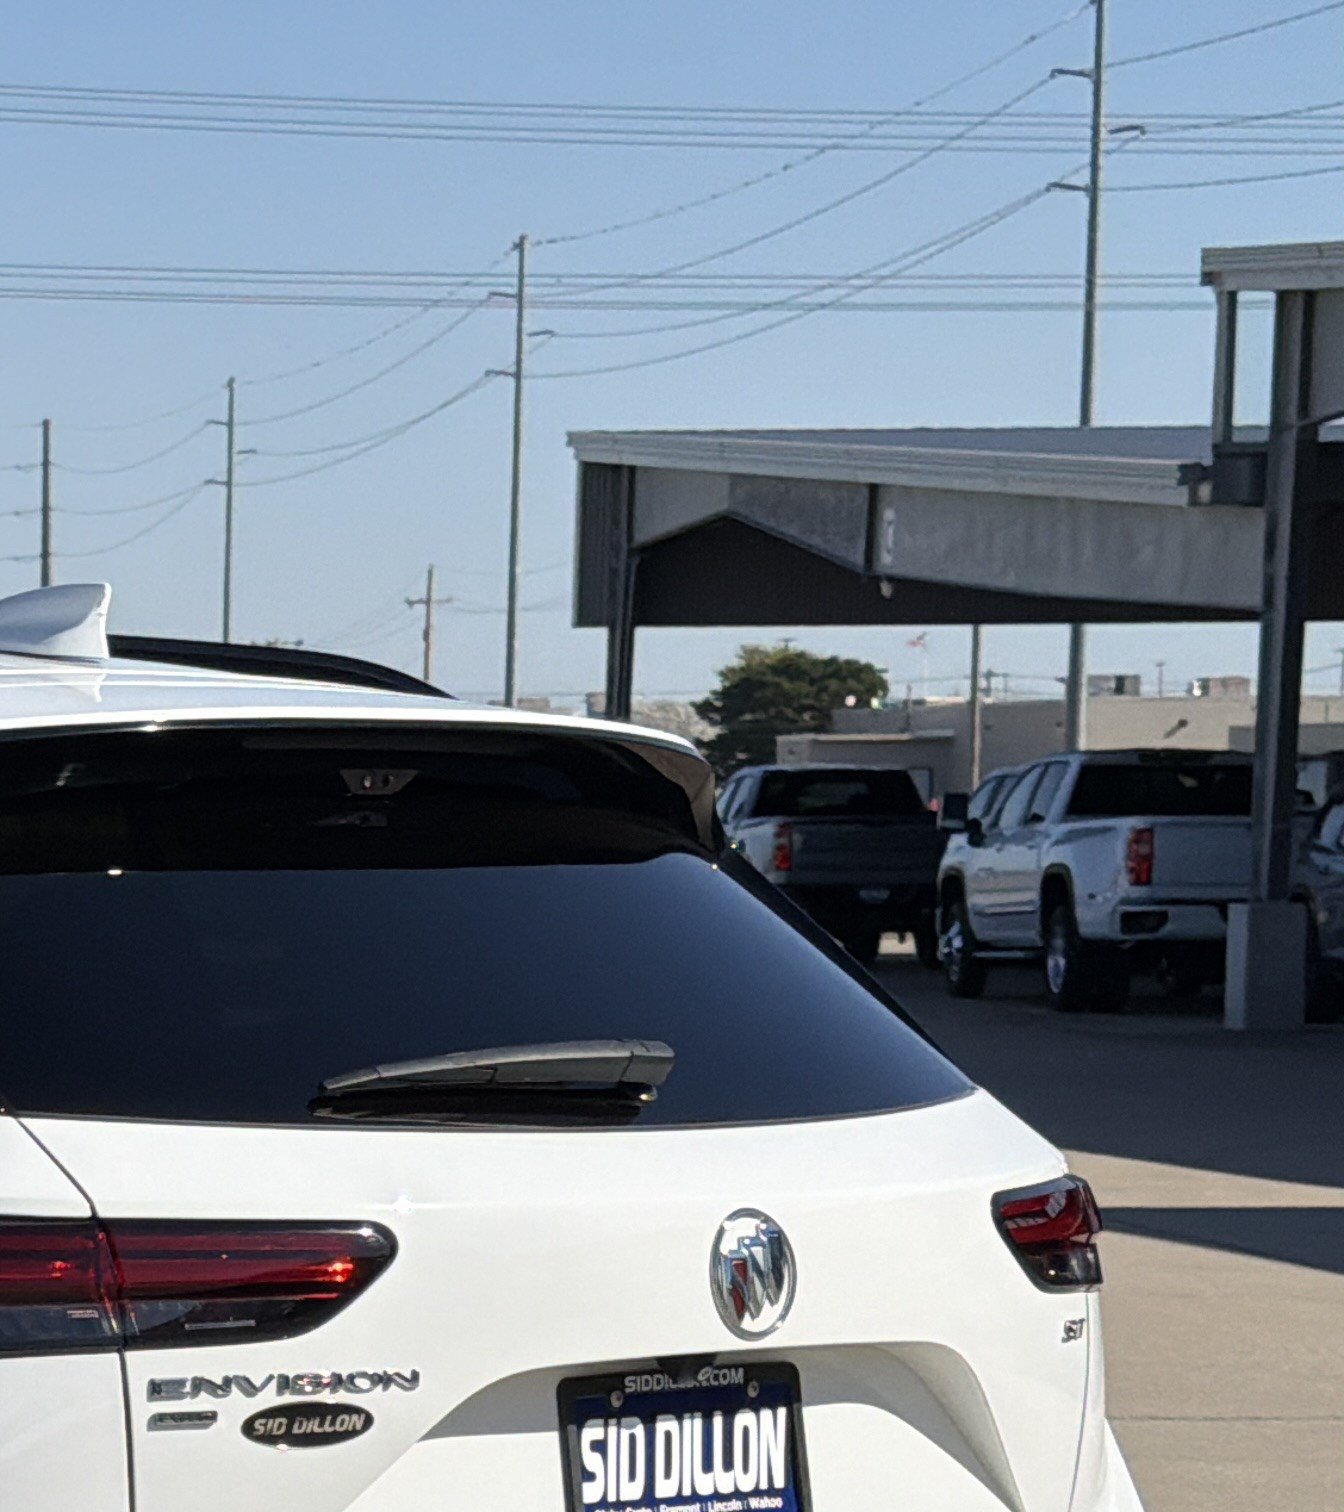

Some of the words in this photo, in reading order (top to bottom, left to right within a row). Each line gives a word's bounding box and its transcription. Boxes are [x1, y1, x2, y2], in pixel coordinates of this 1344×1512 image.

[146, 1369, 420, 1402] ENVISION
[252, 1417, 288, 1436] SID
[291, 1413, 366, 1435] DILLON
[580, 1416, 646, 1504] SID
[654, 1406, 787, 1499] DILLON
[707, 1499, 743, 1512] Lincoln
[748, 1496, 783, 1510] Wahoo
